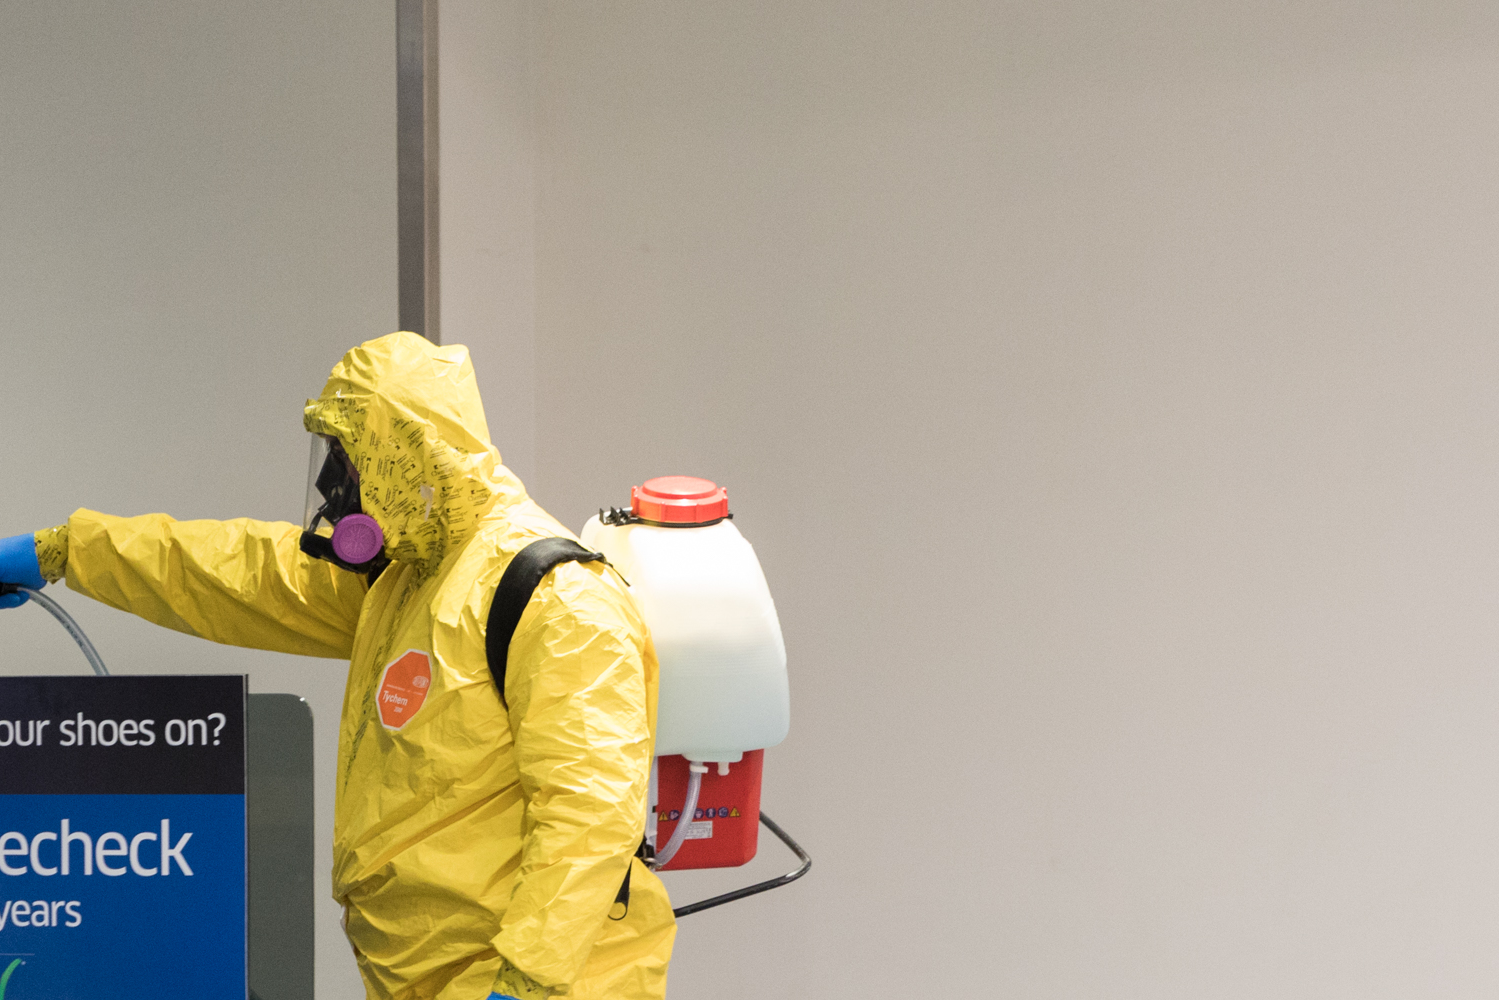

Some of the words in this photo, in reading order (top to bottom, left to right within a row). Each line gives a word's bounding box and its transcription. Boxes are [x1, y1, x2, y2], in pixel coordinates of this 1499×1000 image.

[382, 690, 408, 706] Tychem
[58, 711, 156, 747] shoes
[163, 712, 227, 747] on?
